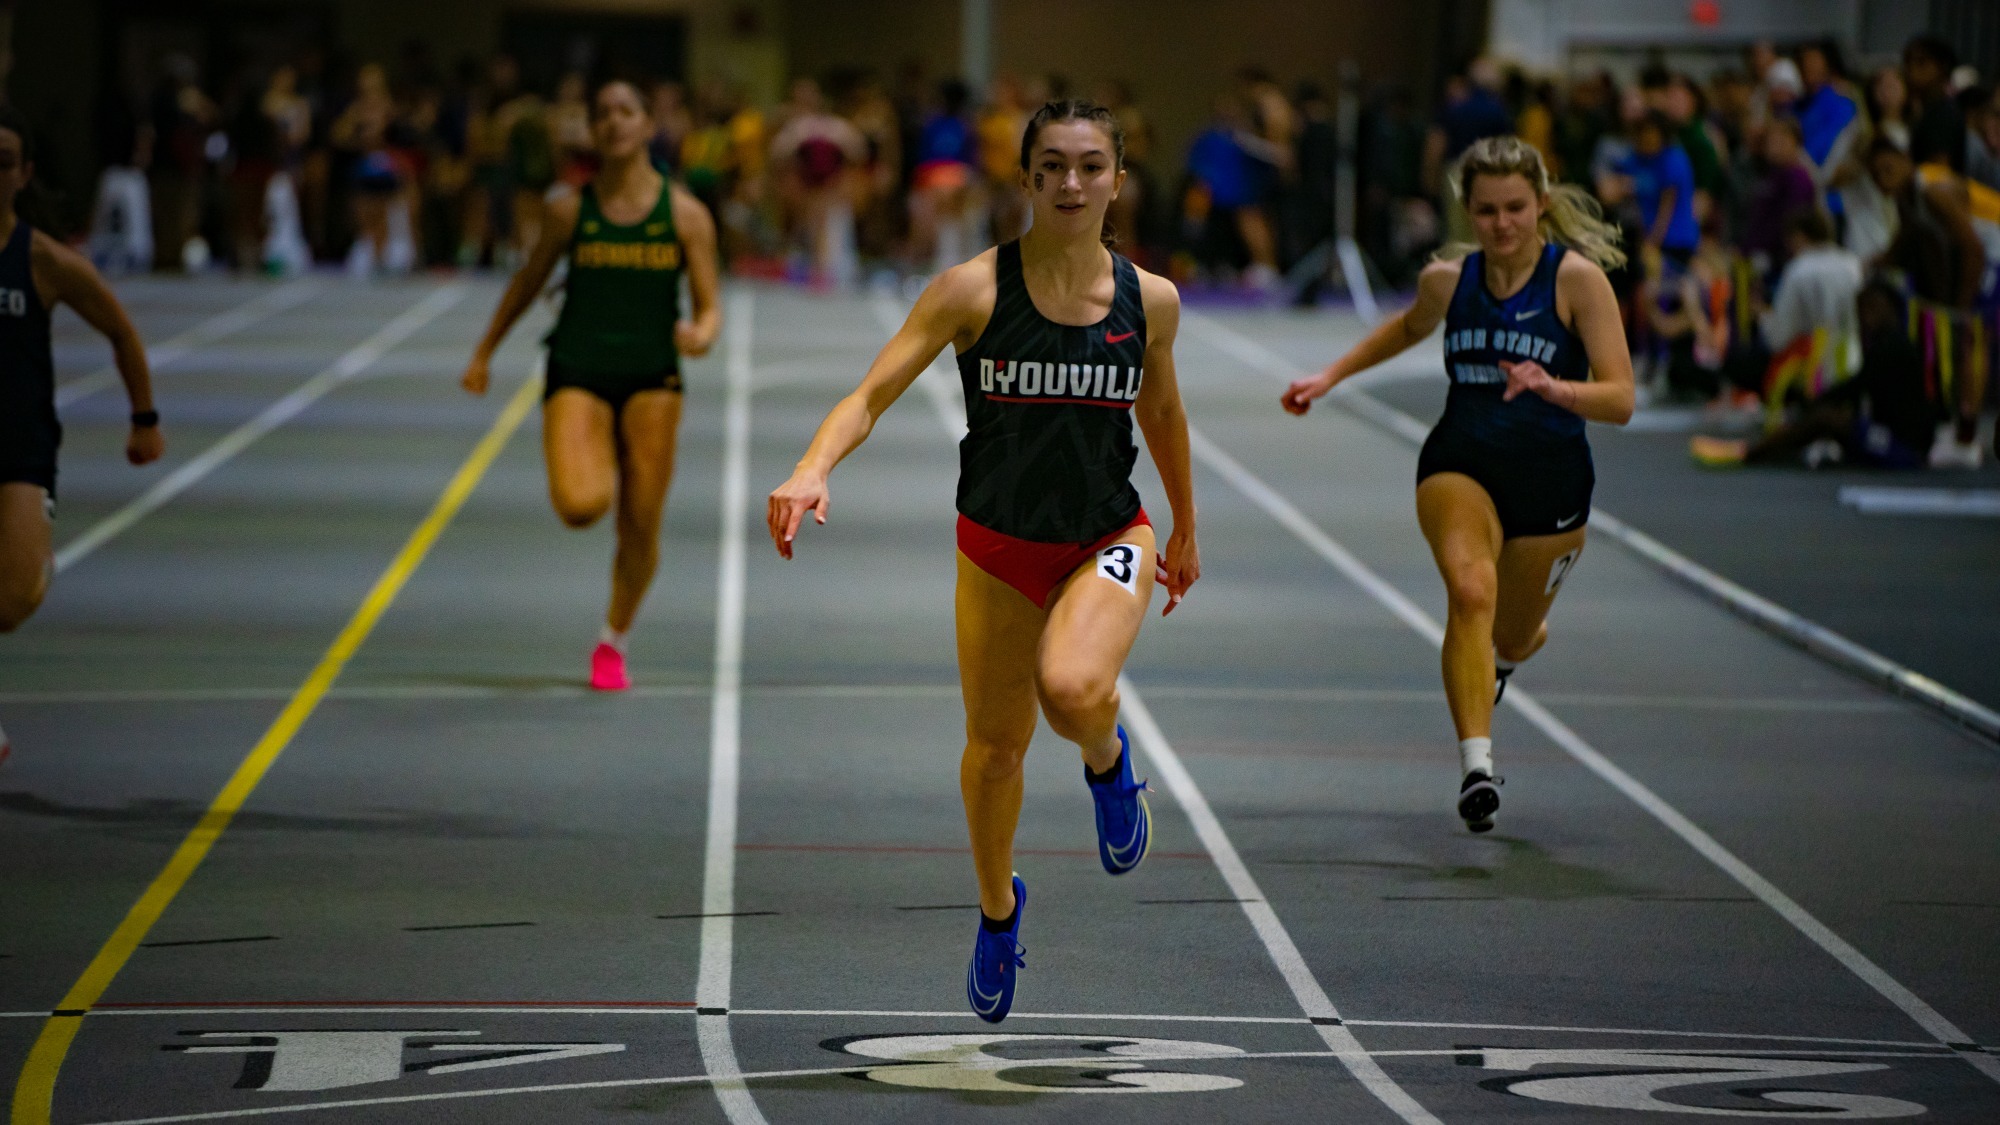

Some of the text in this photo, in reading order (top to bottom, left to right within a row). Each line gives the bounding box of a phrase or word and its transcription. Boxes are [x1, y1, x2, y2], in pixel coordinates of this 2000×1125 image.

[980, 358, 1143, 400] D'YOUVILL
[1103, 546, 1133, 583] 3
[842, 1033, 1246, 1093] 3
[1480, 1047, 1928, 1120] 2
